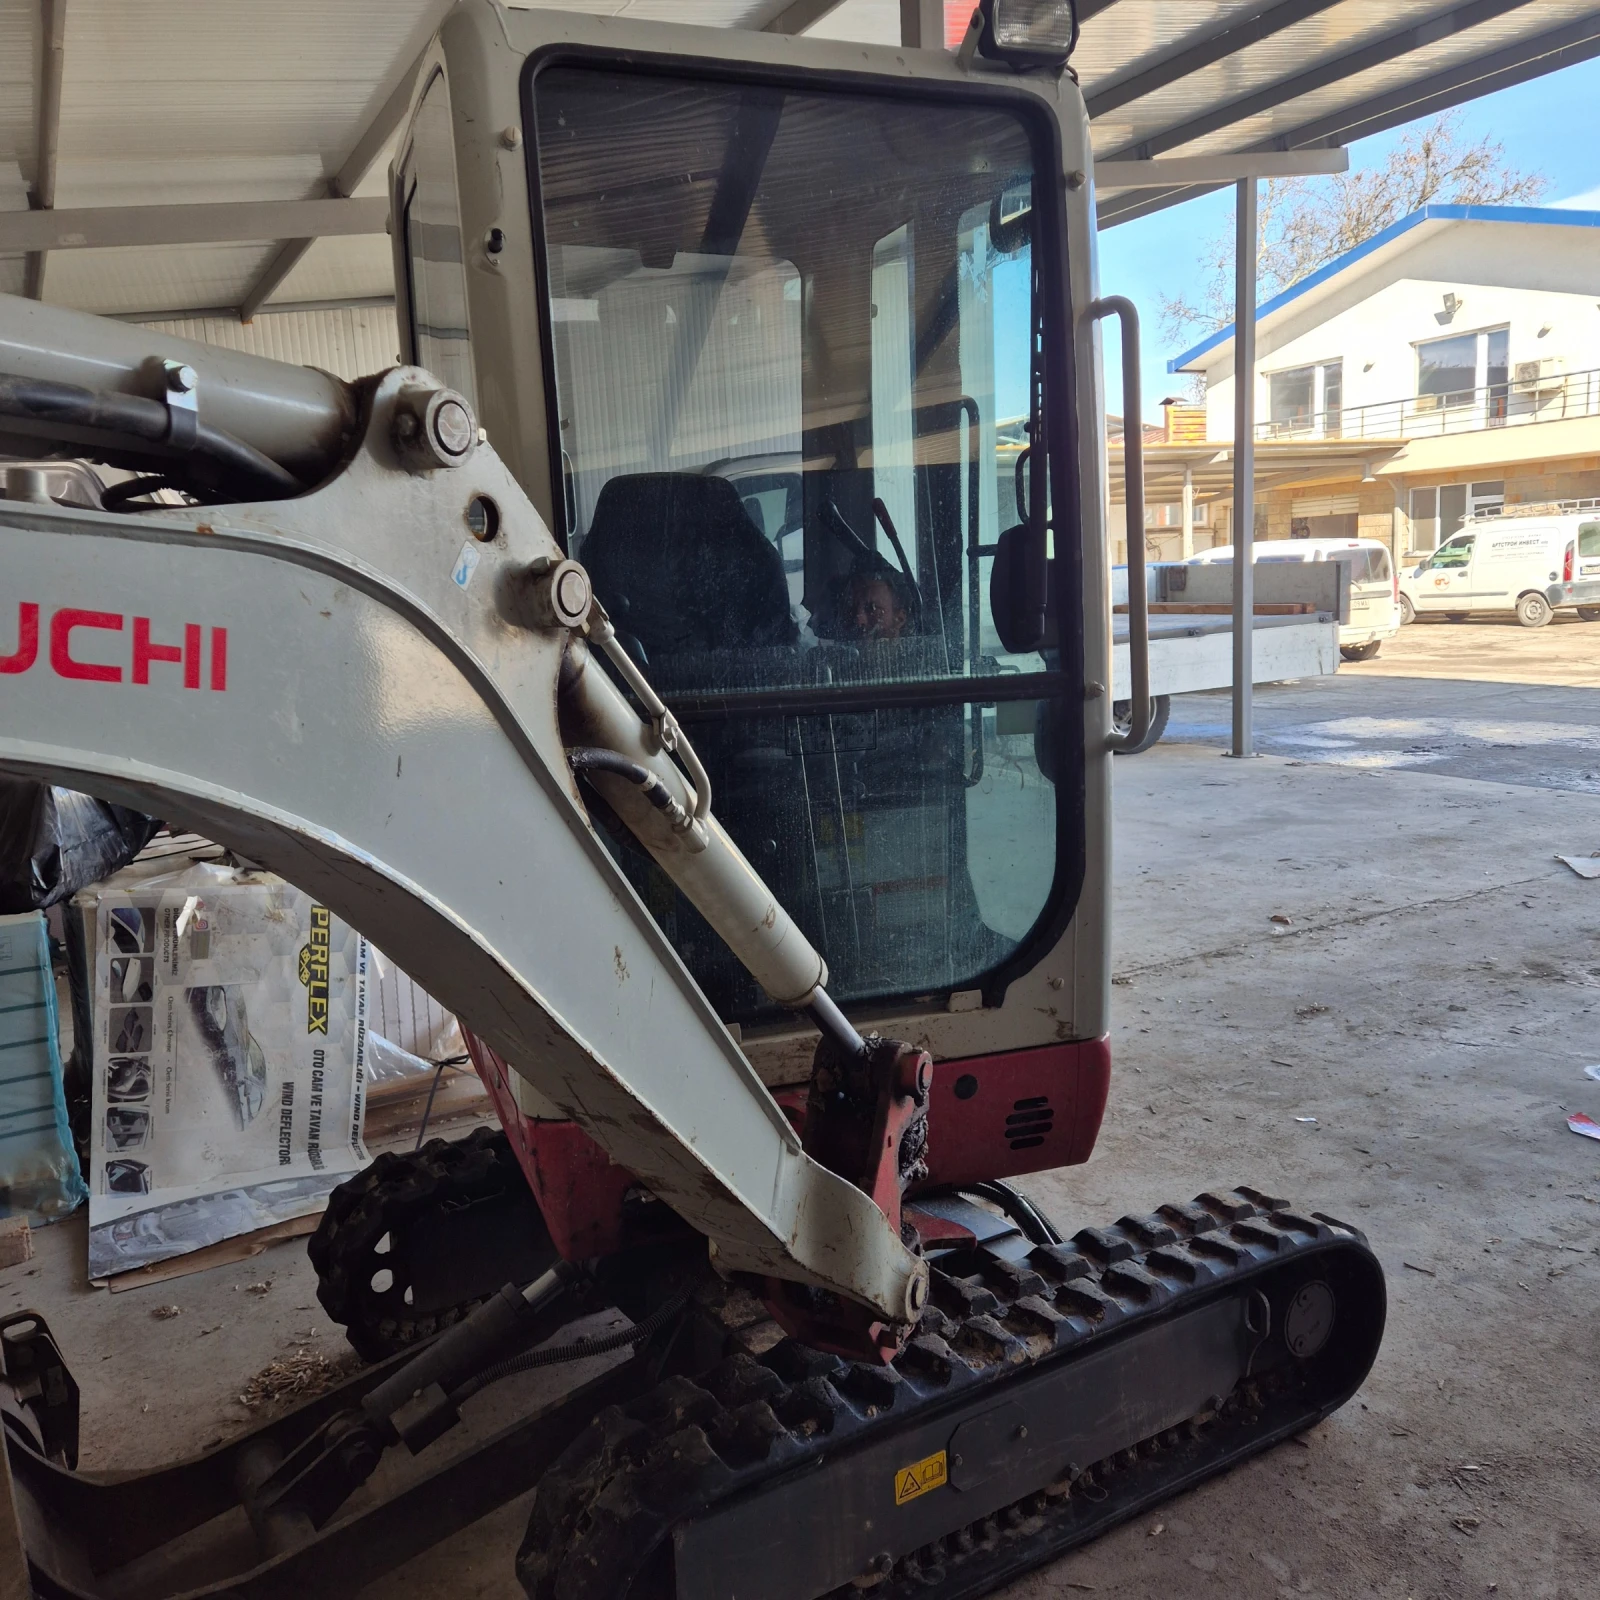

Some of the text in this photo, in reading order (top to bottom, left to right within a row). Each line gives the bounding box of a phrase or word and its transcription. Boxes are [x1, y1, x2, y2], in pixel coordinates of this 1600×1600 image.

[309, 906, 329, 1033] PERFLEX
[359, 962, 366, 976] VE
[358, 979, 366, 1016] TAVAN
[166, 1030, 174, 1052] Chrome
[312, 1049, 325, 1068] OTO
[311, 1070, 324, 1092] CAM
[281, 1082, 294, 1106] WIND
[310, 1095, 322, 1107] VE
[353, 1093, 361, 1121] WIND
[308, 1109, 321, 1140] TAVAN
